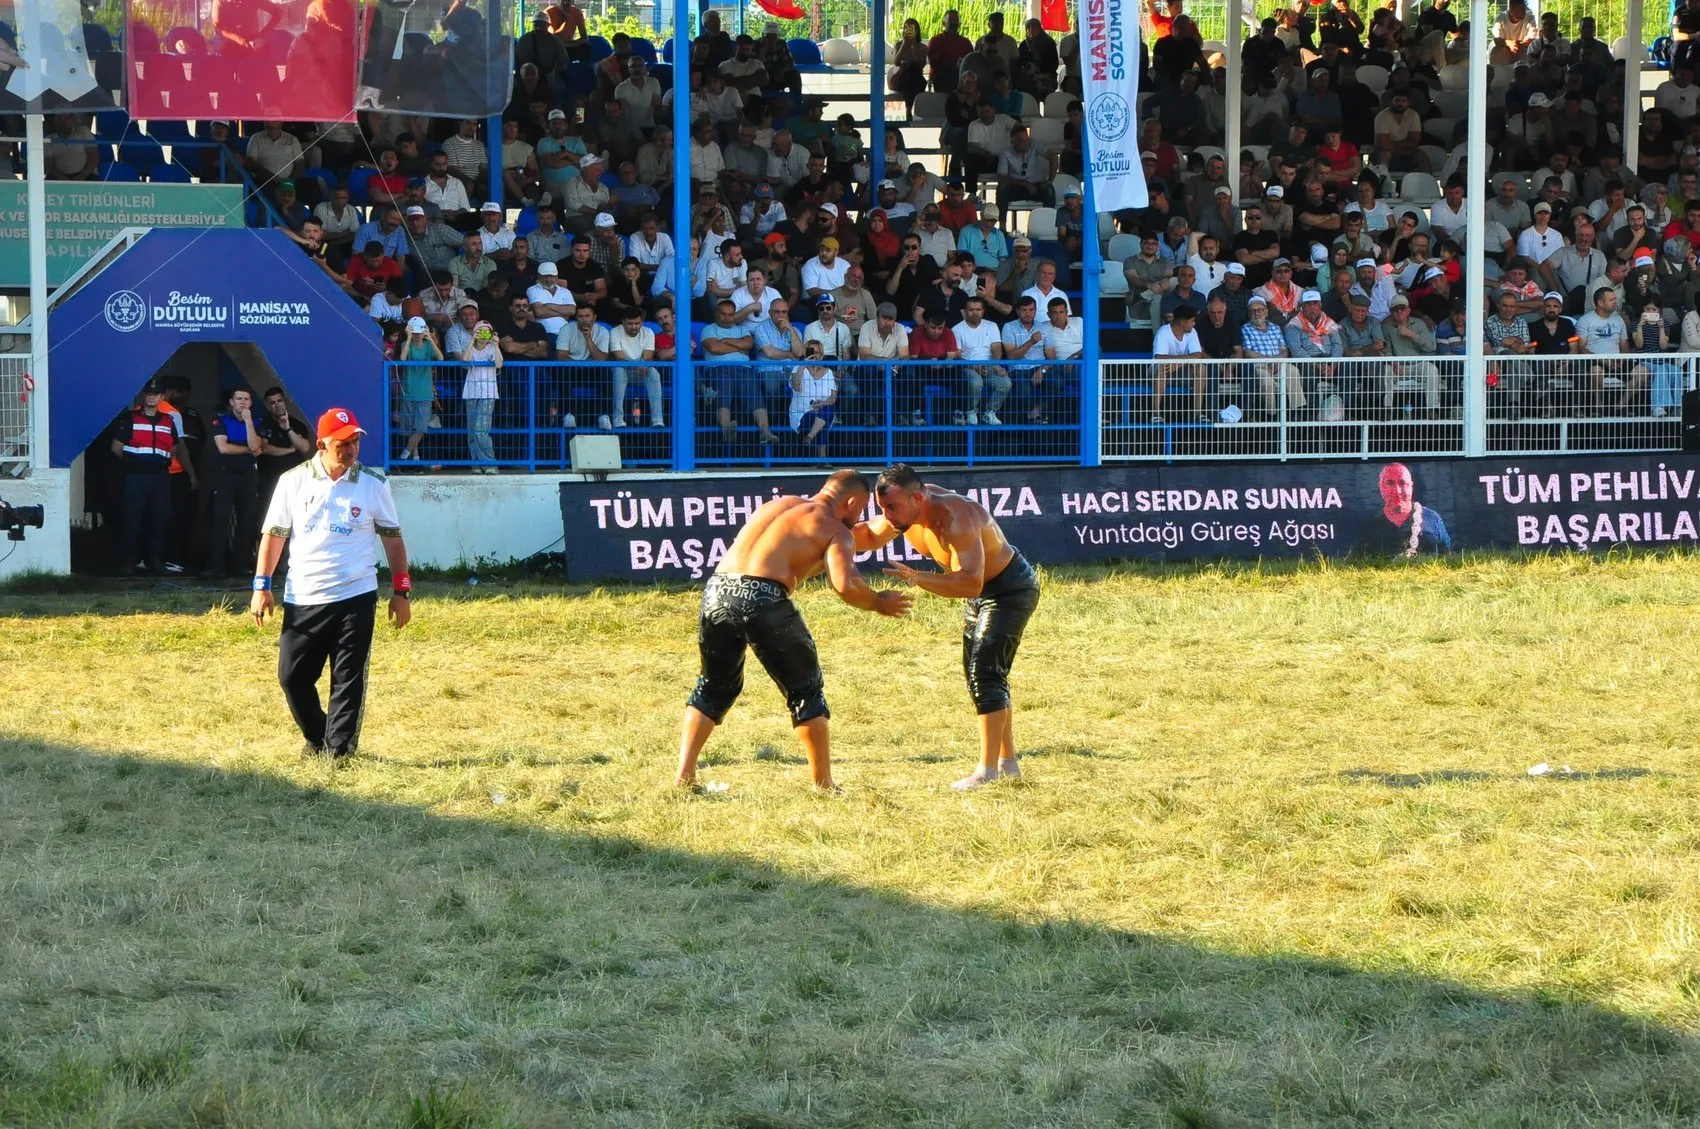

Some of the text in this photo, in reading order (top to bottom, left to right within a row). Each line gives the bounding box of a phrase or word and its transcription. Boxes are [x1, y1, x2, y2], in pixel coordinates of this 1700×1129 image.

[1097, 150, 1124, 161] Besim
[17, 192, 155, 208] KEY TRİBÜNLERİ
[64, 210, 130, 224] BAKANLIĞI
[132, 213, 226, 226] DESTEKLERİYLE
[168, 291, 212, 306] Besim
[154, 307, 227, 321] DUTLULU
[239, 301, 310, 314] MANİSA'YA
[239, 314, 310, 325] SÖZÜMÜZ VAR
[1479, 463, 1700, 504] TÜM PEHLİV
[1062, 487, 1343, 515] HACI SERDAR SUNMA
[590, 490, 674, 529] TÜM
[1073, 520, 1335, 548] Yuntdağı Güreş Ağası
[1517, 510, 1700, 551] BAŞARILA
